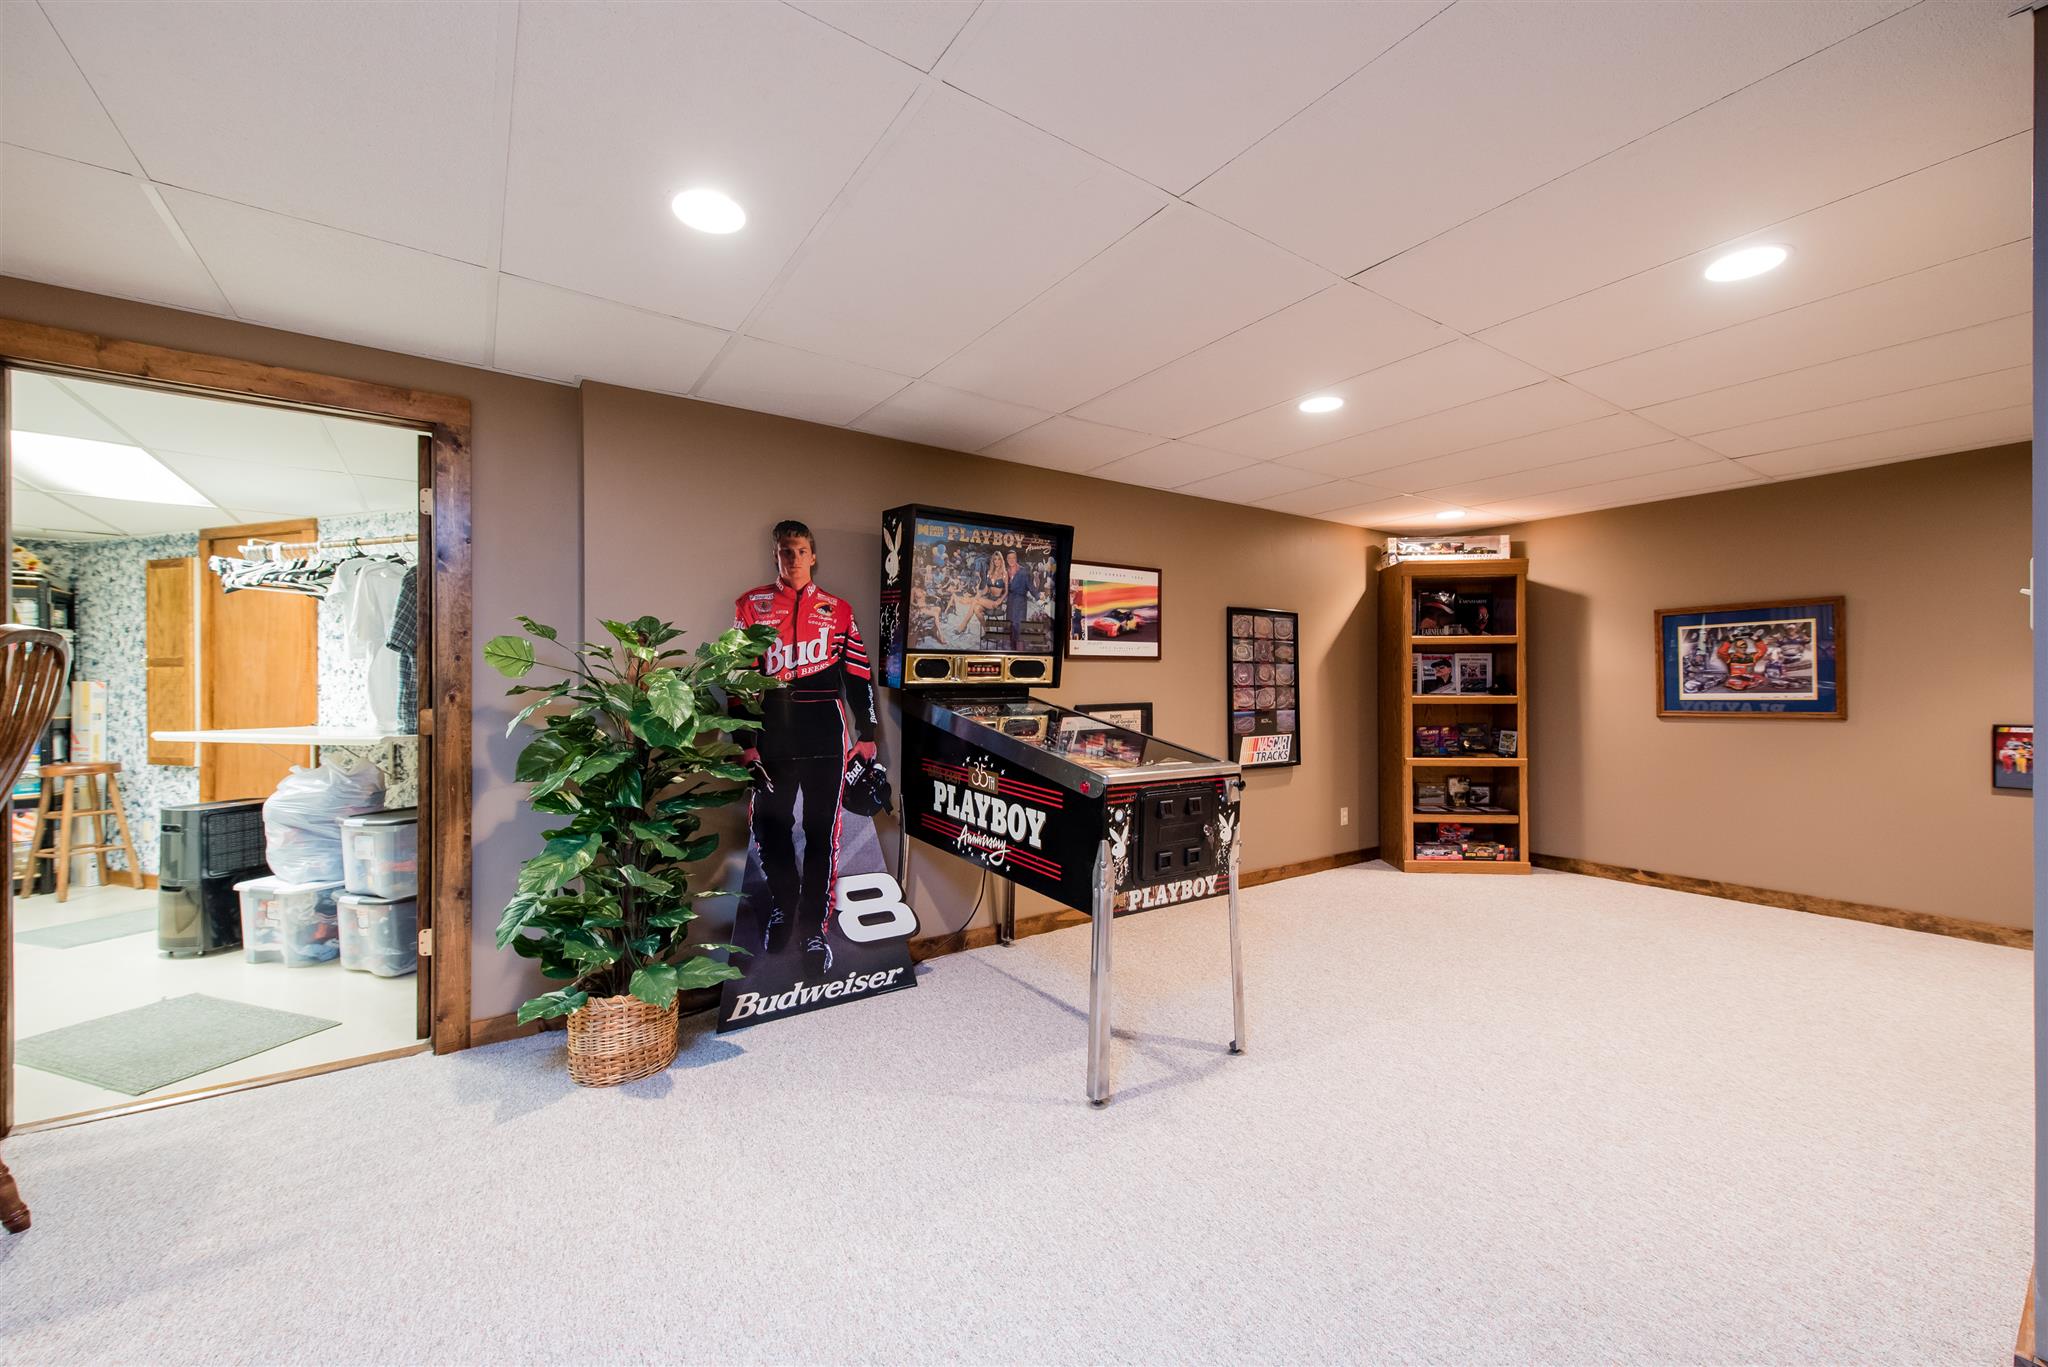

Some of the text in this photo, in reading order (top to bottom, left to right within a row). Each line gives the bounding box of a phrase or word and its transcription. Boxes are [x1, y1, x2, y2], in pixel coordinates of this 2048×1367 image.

[947, 525, 1025, 549] PLAYBOY
[765, 626, 831, 677] Bud
[801, 662, 831, 676] BEERS
[868, 683, 879, 725] Budweiser
[1255, 749, 1289, 763] TRACKS
[1257, 735, 1291, 752] NASCAR
[845, 760, 864, 786] Bud
[970, 760, 996, 791] 35TH
[933, 780, 1047, 849] PLAYBOY
[957, 823, 1011, 866] Anniversary
[833, 872, 917, 943] 8
[1128, 873, 1219, 912] PLAYBOY
[726, 966, 904, 1023] Budweiser
